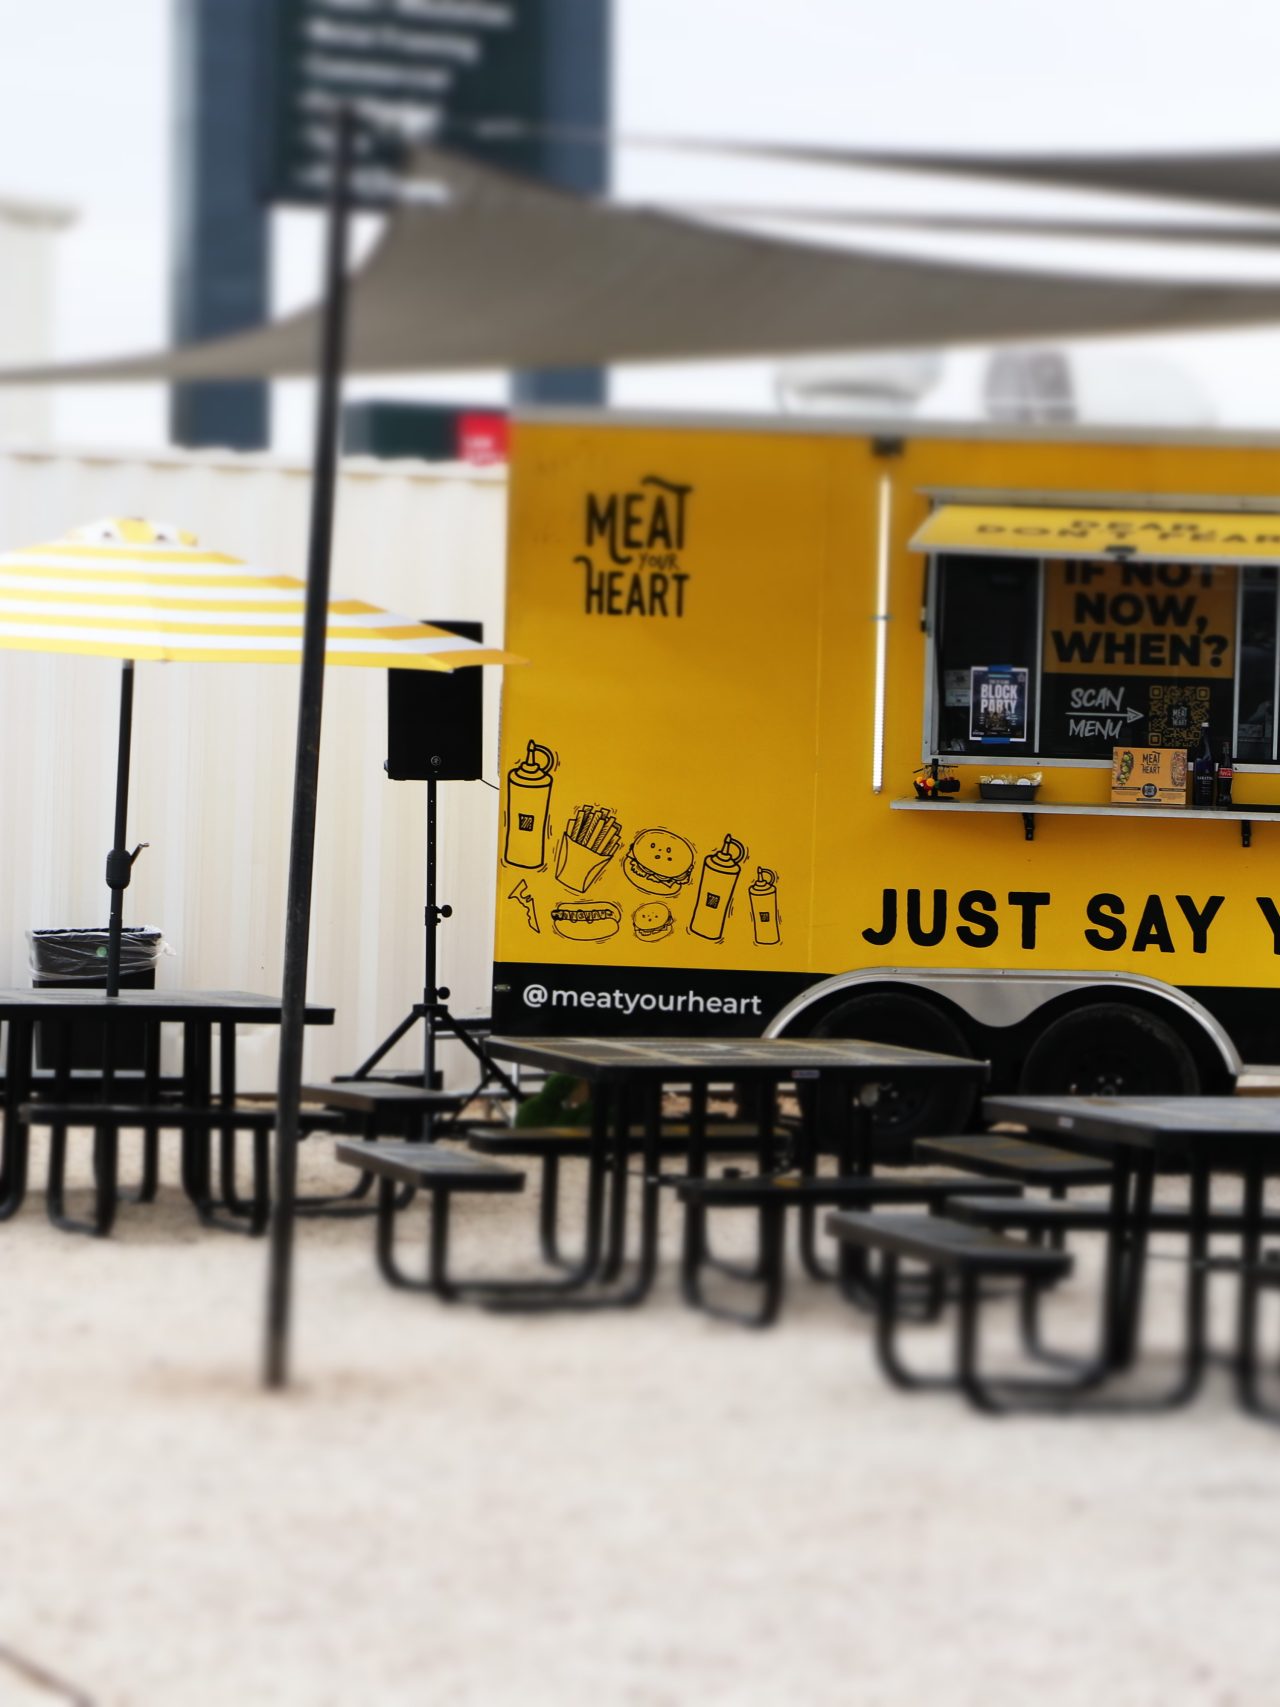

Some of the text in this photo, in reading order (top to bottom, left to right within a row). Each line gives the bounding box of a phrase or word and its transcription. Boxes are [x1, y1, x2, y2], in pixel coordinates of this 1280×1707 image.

[586, 475, 693, 565] MEAT
[1065, 560, 1104, 584] IF
[573, 555, 690, 618] HEART
[1075, 593, 1208, 634] NOW,
[1051, 631, 1228, 667] WHEN?
[981, 683, 1018, 699] BLOCK
[1070, 686, 1125, 711] SCAN
[981, 699, 1017, 714] PARTY
[1069, 719, 1123, 740] MENU
[1140, 763, 1161, 774] HEART
[1142, 750, 1161, 765] MEAT
[862, 888, 1051, 950] JUST
[1084, 892, 1226, 954] SAY
[522, 983, 762, 1015] @meatyourheart
